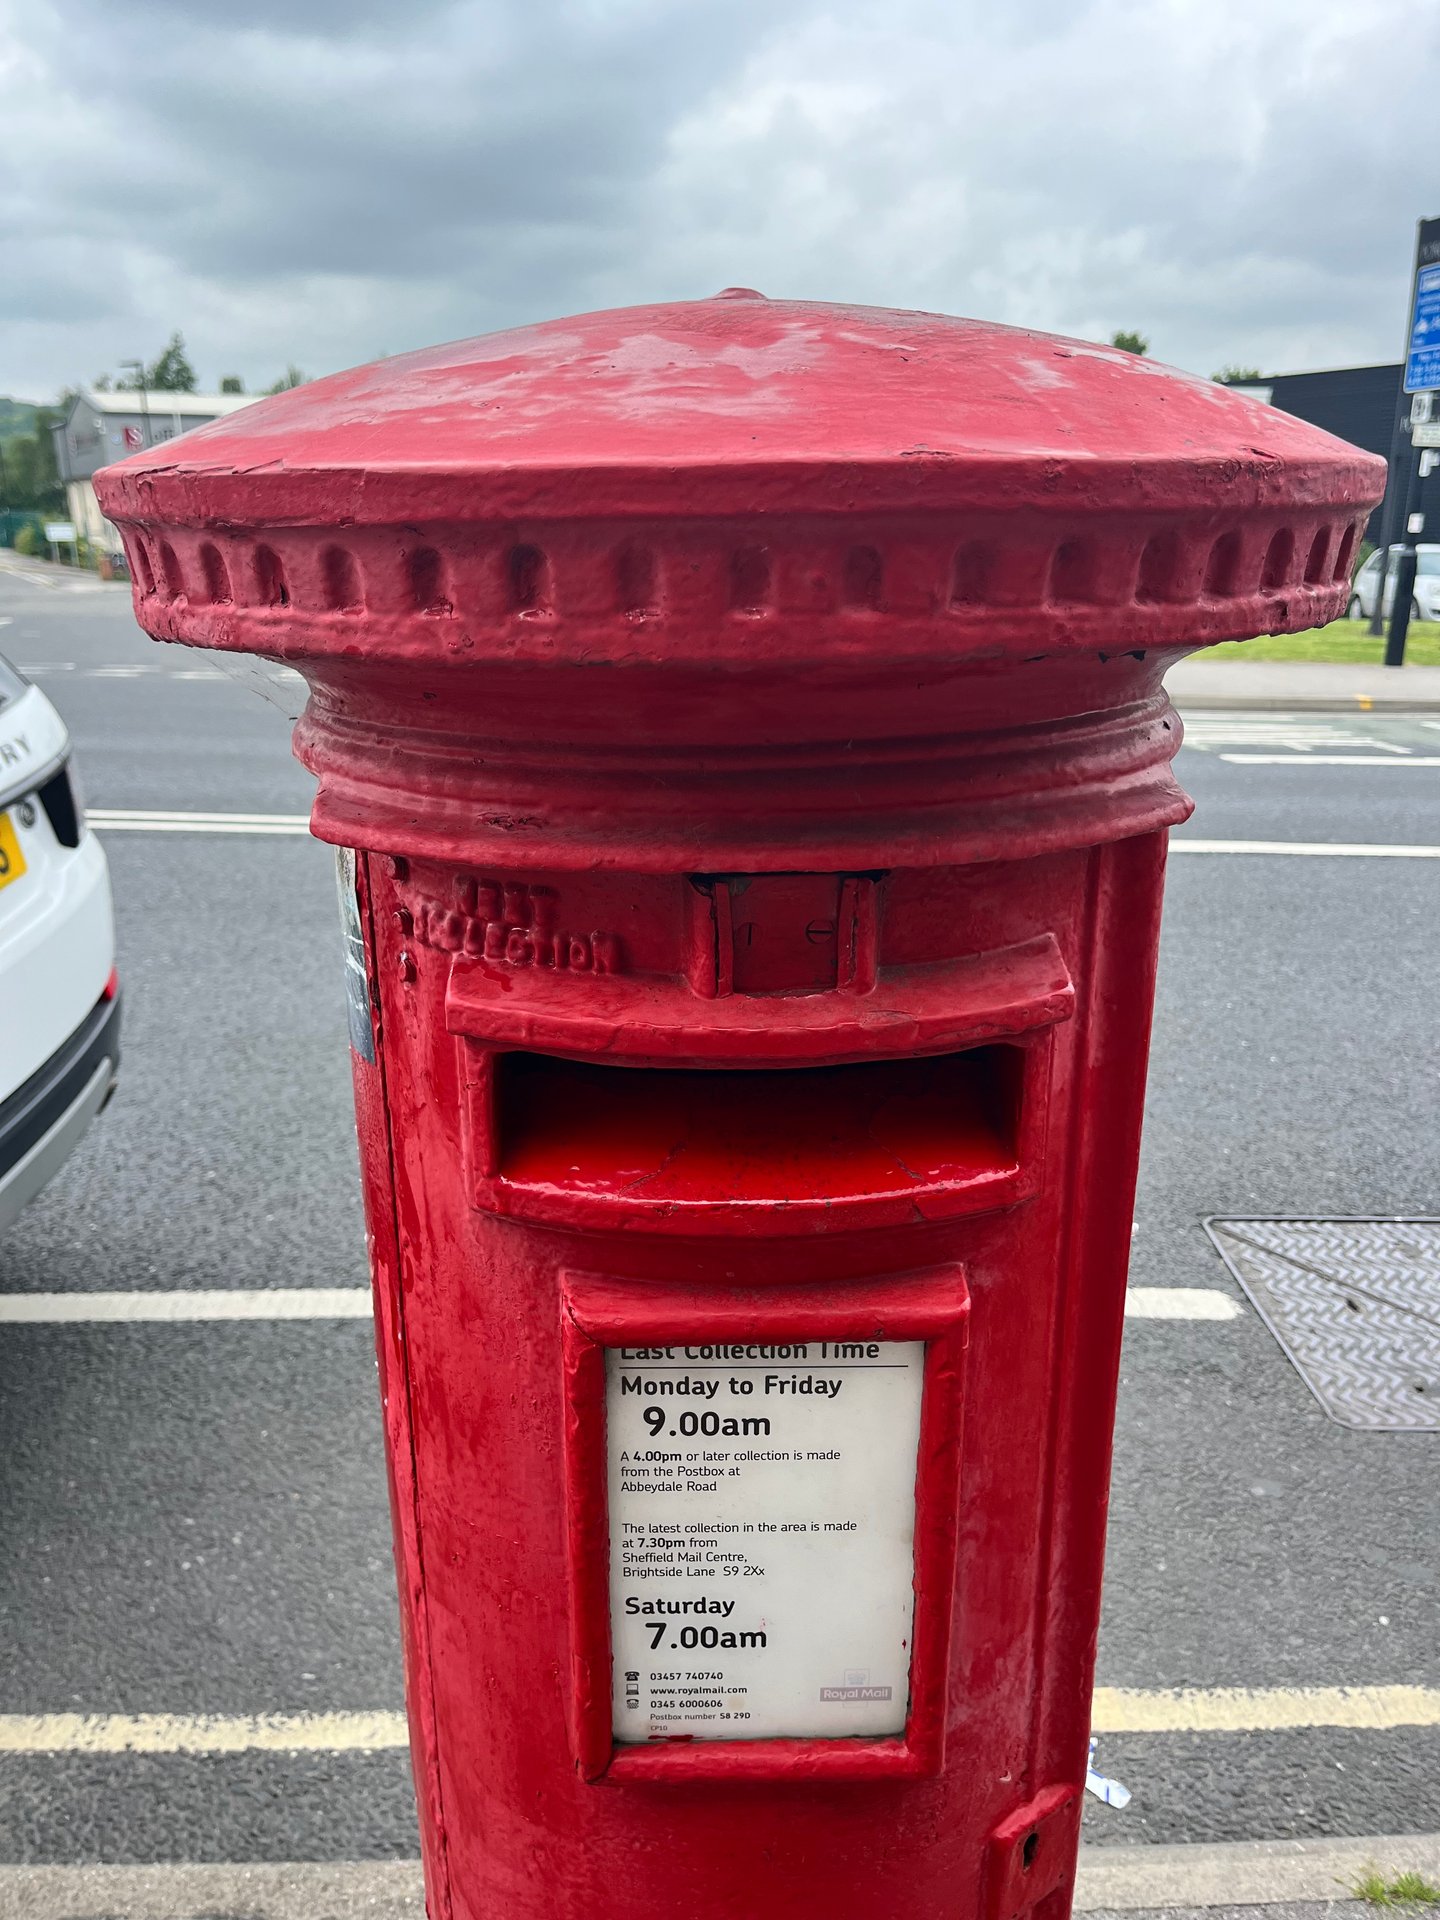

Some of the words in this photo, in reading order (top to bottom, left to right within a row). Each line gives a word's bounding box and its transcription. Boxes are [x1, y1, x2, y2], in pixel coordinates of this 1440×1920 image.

[620, 1344, 676, 1360] Last
[683, 1343, 808, 1360] Collection
[621, 1375, 720, 1400] Monday
[729, 1378, 754, 1396] to
[764, 1374, 843, 1399] Friday
[643, 1406, 771, 1437] 9.00am
[620, 1451, 630, 1462] A
[633, 1451, 682, 1464] 4.00pm
[686, 1452, 700, 1462] or
[703, 1450, 731, 1462] later
[734, 1450, 790, 1461] collection
[793, 1450, 803, 1461] is
[807, 1449, 841, 1461] made
[620, 1466, 650, 1477] from
[654, 1466, 674, 1477] the
[677, 1466, 725, 1477] Postbox
[728, 1466, 741, 1477] at
[620, 1481, 683, 1495] Abbeydale
[686, 1481, 717, 1493] Road
[622, 1522, 645, 1534] The
[648, 1522, 681, 1534] latest
[684, 1522, 740, 1534] collection
[743, 1522, 754, 1533] in
[758, 1522, 777, 1533] the
[781, 1522, 807, 1533] area
[811, 1521, 820, 1533] is
[824, 1521, 858, 1532] made
[622, 1538, 635, 1549] at
[637, 1538, 685, 1551] 7.30pm
[689, 1537, 718, 1549] from
[622, 1552, 674, 1564] Sheffield
[677, 1552, 703, 1563] Mail
[705, 1551, 748, 1564] Centre,
[623, 1566, 683, 1580] Brightside
[686, 1566, 716, 1578] Lane
[723, 1566, 740, 1577] S9
[743, 1566, 766, 1577] 2Xx
[625, 1597, 736, 1618] Saturday
[645, 1622, 768, 1651] 7.00am
[650, 1672, 682, 1682] 03457
[685, 1671, 724, 1681] 740740
[650, 1685, 748, 1696] www.royalmail.com
[823, 1687, 858, 1702] Royal
[861, 1687, 889, 1700] Mail
[650, 1700, 675, 1709] 0345
[679, 1699, 723, 1709] 6000606
[650, 1713, 682, 1721] Postbox
[685, 1713, 717, 1721] number
[733, 1712, 752, 1720] 29D
